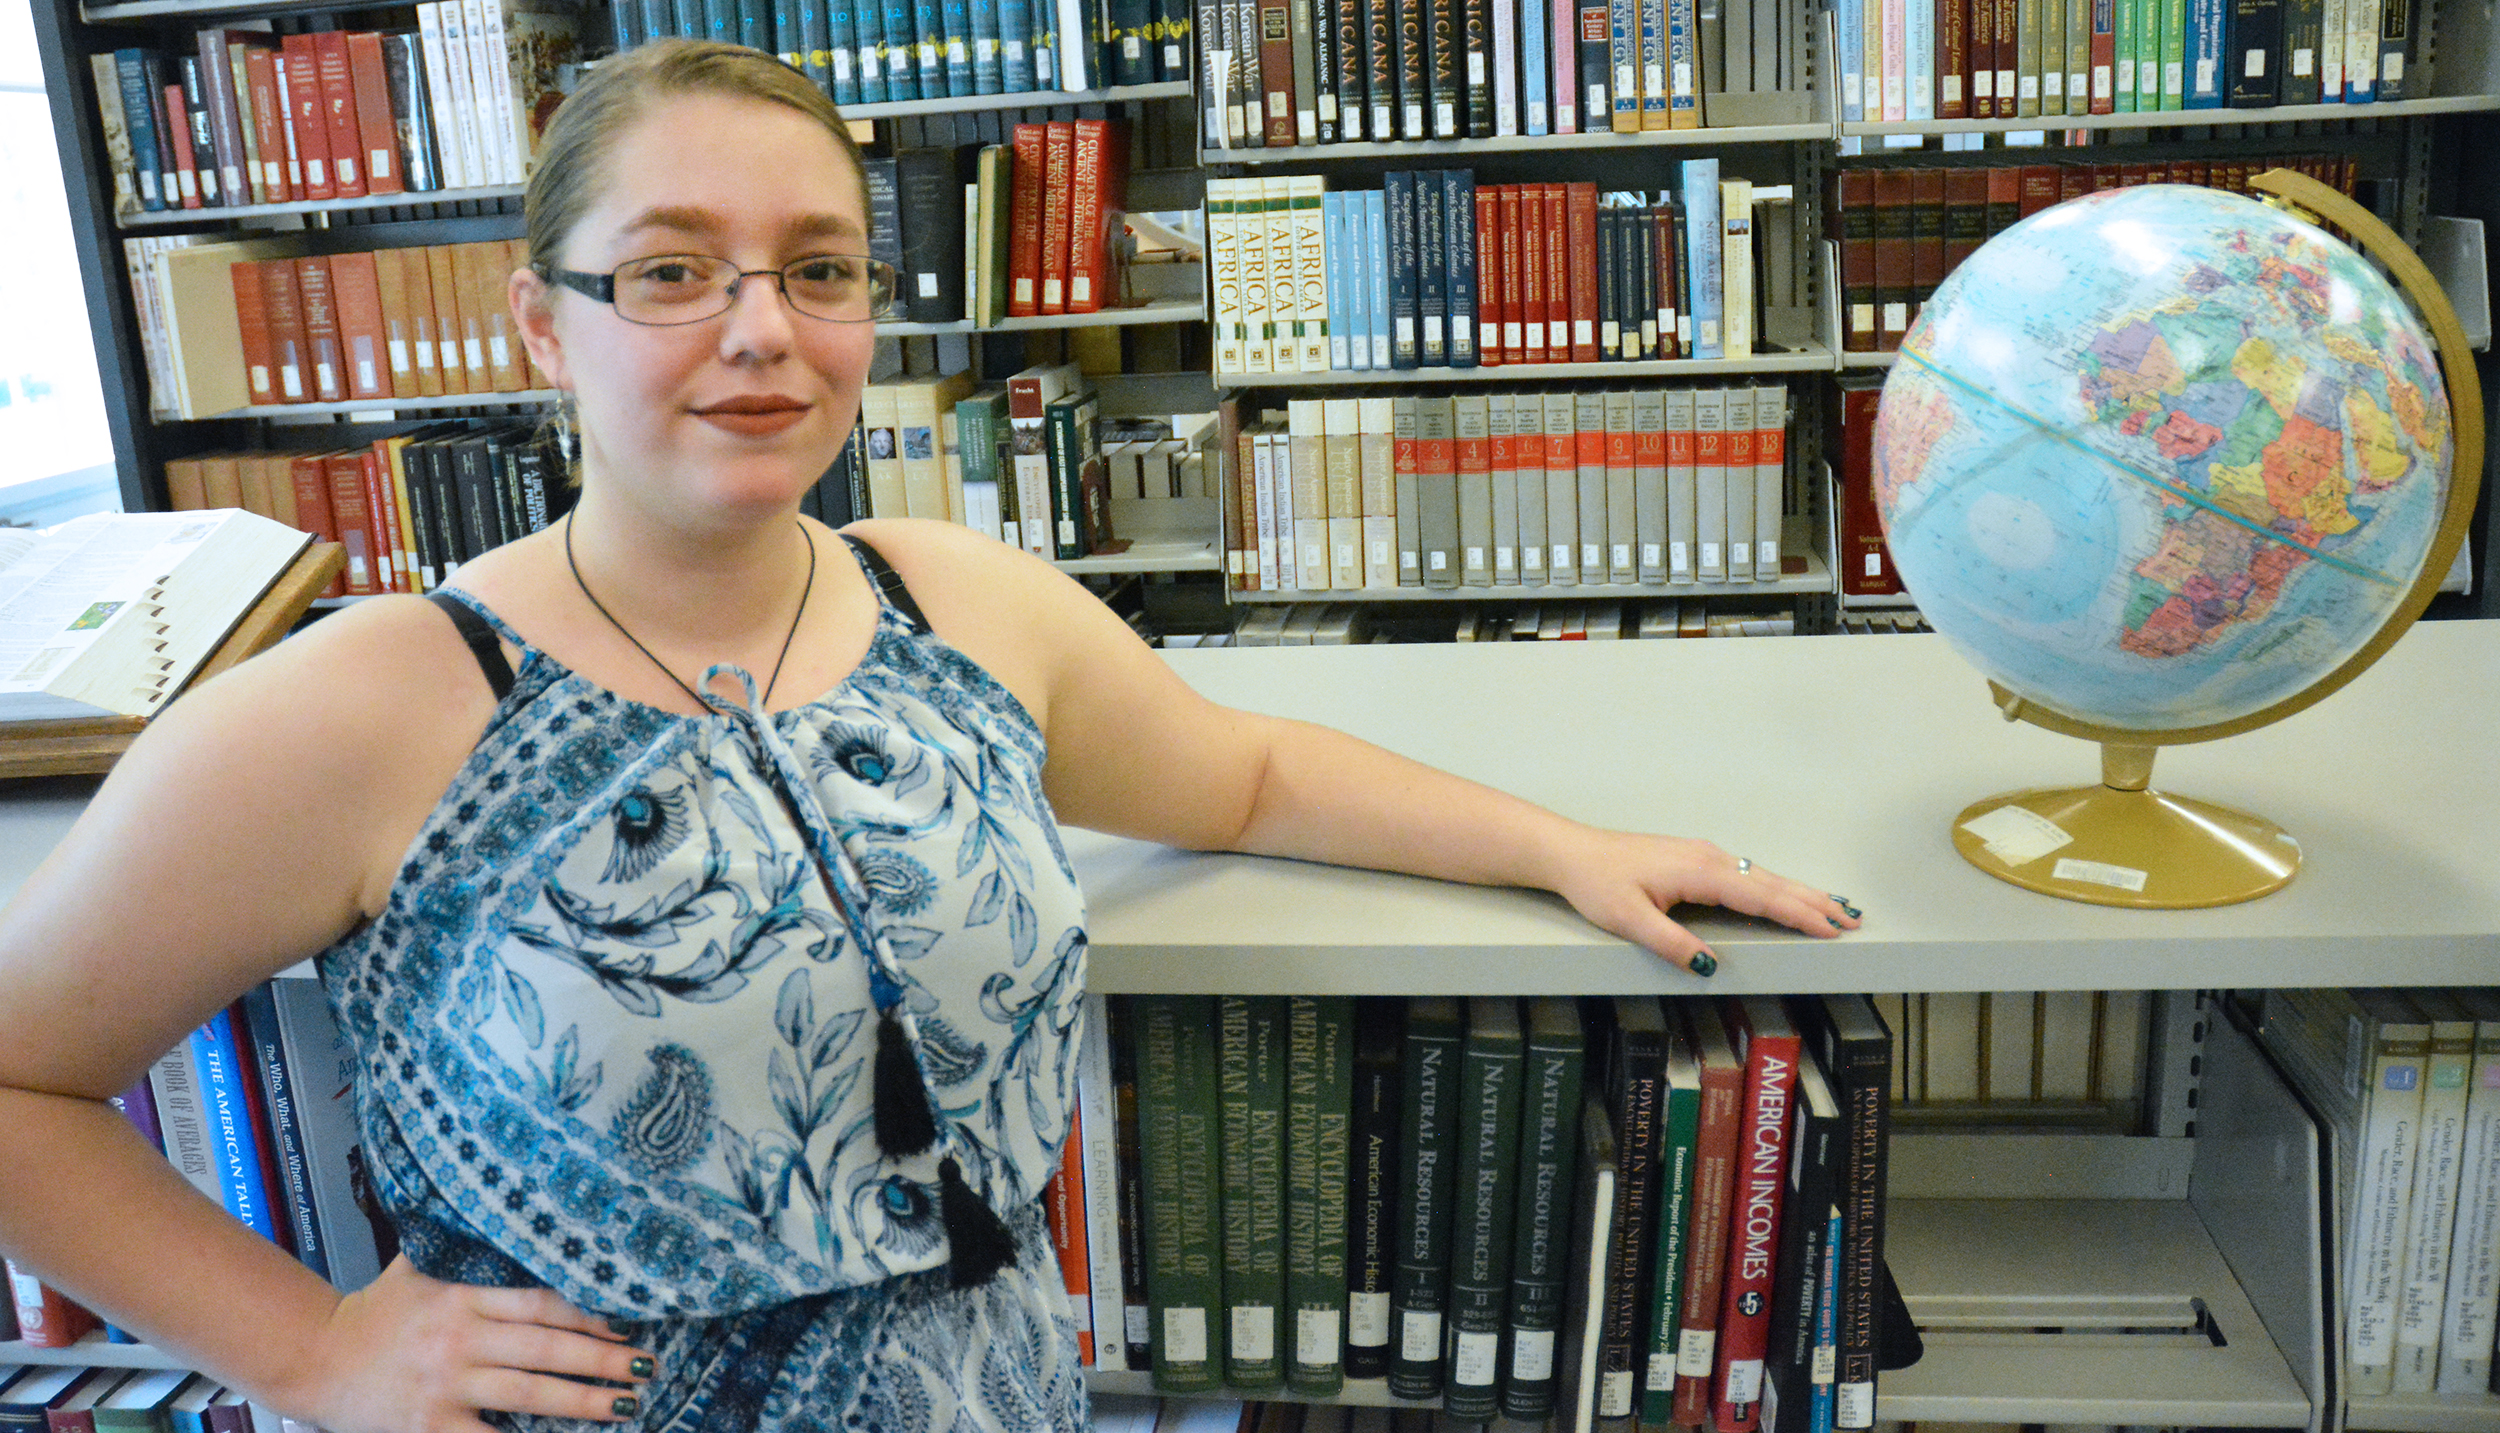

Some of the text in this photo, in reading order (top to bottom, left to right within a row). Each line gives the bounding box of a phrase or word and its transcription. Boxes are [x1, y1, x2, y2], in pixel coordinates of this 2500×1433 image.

[777, 13, 786, 27] 8
[804, 9, 813, 23] 9
[830, 11, 848, 23] 10
[859, 10, 873, 21] 11
[887, 6, 902, 19] 12
[918, 5, 931, 18] 13
[946, 3, 962, 15] 14
[2332, 6, 2340, 32] Years
[2361, 4, 2373, 31] Years
[1221, 3, 1237, 51] Korea
[1318, 19, 1328, 39] WAR
[1240, 2, 1259, 91] Korean War
[1319, 42, 1329, 85] ALMANAC
[1889, 54, 1898, 77] Cultur
[1044, 142, 1058, 271] ANCIENT MEDITERRANEAN
[1055, 141, 1069, 242] CIVILIZATION OF THE
[1072, 139, 1087, 267] ANCIENT MEDITERRANEAN
[1083, 139, 1099, 240] CIVILIZATION OF THE
[1447, 180, 1460, 278] North American Colonies
[1460, 190, 1471, 242] Encyclopedia
[1216, 230, 1239, 315] AFRICA
[1243, 229, 1267, 316] AFRICA
[1271, 226, 1295, 314] AFRICA
[1300, 226, 1324, 313] AFRICA
[1464, 253, 1472, 267] the
[1456, 284, 1466, 293] III
[1401, 442, 1412, 459] 2
[1431, 443, 1442, 460] 3
[1468, 441, 1477, 458] 4
[1496, 440, 1505, 456] 5
[1554, 438, 1564, 455] 7
[1614, 438, 1624, 455] 9
[1642, 435, 1660, 450] 10
[1670, 436, 1686, 452] 11
[1700, 435, 1718, 451] 12
[1732, 435, 1750, 451] 13
[1761, 434, 1778, 451] 13
[530, 470, 542, 478] A
[522, 473, 538, 532] OF POLITICS
[1279, 492, 1288, 516] Indian
[1281, 517, 1289, 537] Tribe
[207, 1049, 224, 1084] THE
[266, 1044, 276, 1061] The
[1257, 1020, 1270, 1083] Porter
[1325, 1022, 1338, 1084] Porter
[268, 1063, 283, 1094] Who,
[2403, 1069, 2410, 1085] 1
[161, 1061, 208, 1176] BOOK OF AVERAGES
[215, 1087, 244, 1178] AMERICAN
[1222, 997, 1250, 1275] AMERICAN ECONOMIC HISTORY
[283, 1134, 295, 1152] and
[1150, 1106, 1179, 1194] ECONOMIC
[1291, 998, 1317, 1278] AMERICAN ECONOMIC HISTORY
[1414, 1047, 1442, 1260] NATURAL RESOURCES
[2393, 1121, 2408, 1157] Gender,
[288, 1154, 304, 1192] Where
[1093, 1140, 1110, 1218] LEARNING
[1368, 1135, 1383, 1197] American
[1472, 1064, 1504, 1281] NATURAL RESOURCES
[1531, 1058, 1565, 1275] NATURAL RESOURCES
[1672, 1146, 1687, 1192] Economic
[1742, 1055, 1788, 1280] AMERICAN INCOMES
[295, 1193, 307, 1204] of
[1180, 1115, 1209, 1277] ENCYCLOPEDIA OF
[1252, 1110, 1278, 1273] ENCYCLOPEDIA OF
[1318, 1113, 1346, 1278] ENCYCLOPEDIA OF
[1619, 1079, 1654, 1338] POVERTY IN THE UNITED STATES
[1668, 1193, 1683, 1224] Report
[2388, 1187, 2399, 1204] and
[298, 1205, 317, 1251] America
[1366, 1200, 1382, 1258] Economic
[1670, 1225, 1680, 1236] of
[1857, 1087, 1879, 1348] POVERTY IN THE UNITED STATES
[2383, 1206, 2399, 1247] Ethnicity
[1153, 1202, 1181, 1277] HISTORY
[1668, 1237, 1679, 1251] the
[1808, 1231, 1817, 1242] an
[2382, 1249, 2390, 1258] in
[1365, 1261, 1379, 1293] Histo
[1665, 1252, 1678, 1294] President
[1804, 1266, 1815, 1277] of
[2381, 1260, 2392, 1273] the
[1745, 1292, 1758, 1315] 5
[1800, 1278, 1815, 1318] POVERTY
[1658, 1301, 1673, 1341] February
[1800, 1319, 1809, 1327] in
[1795, 1329, 1809, 1365] America
